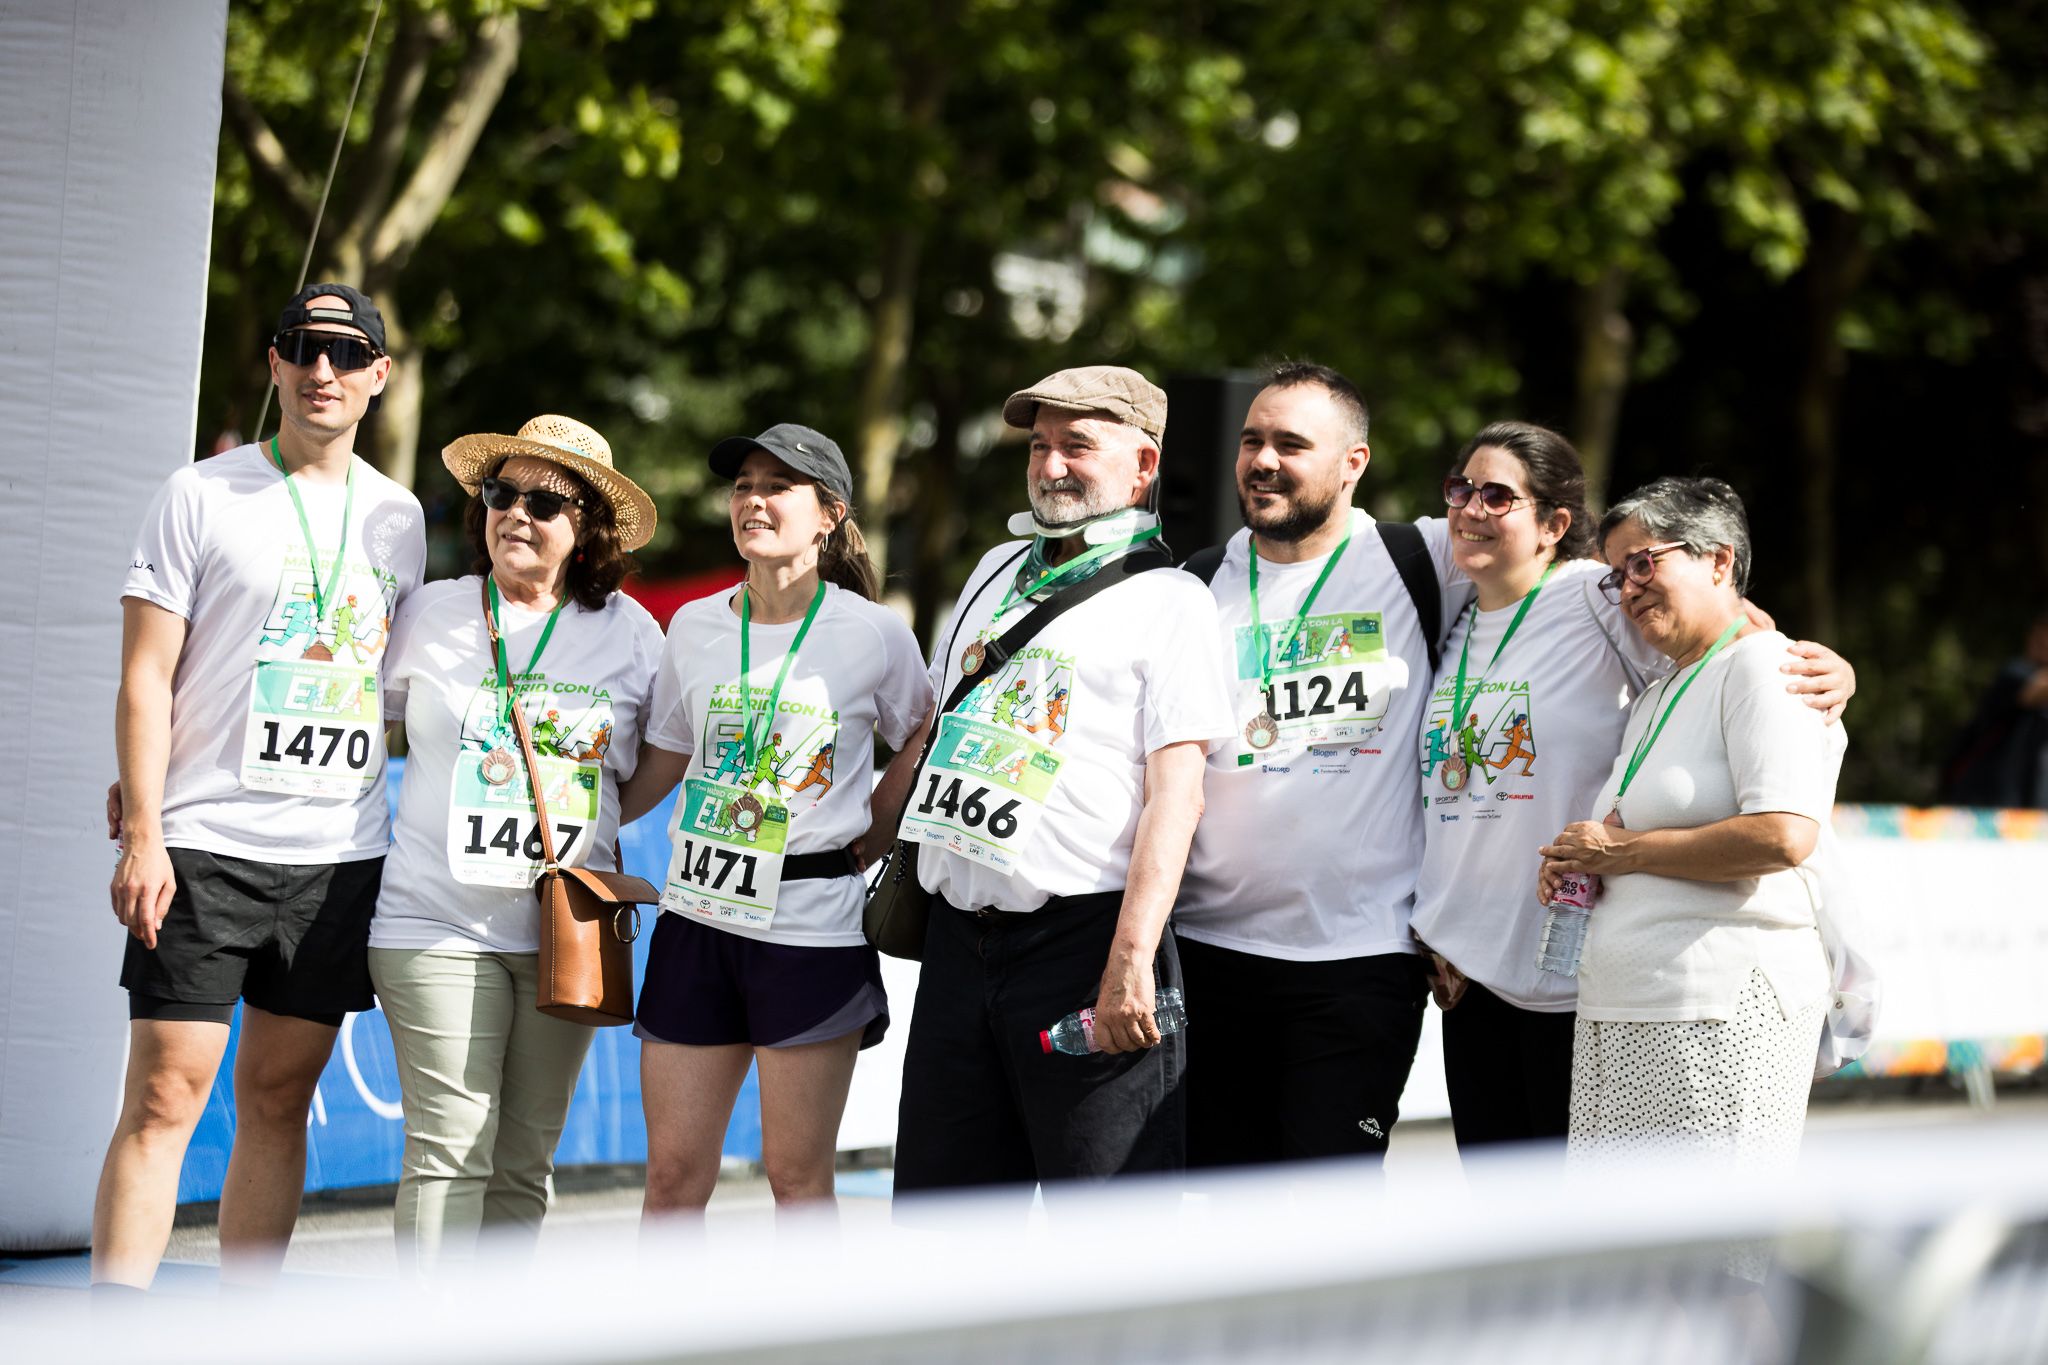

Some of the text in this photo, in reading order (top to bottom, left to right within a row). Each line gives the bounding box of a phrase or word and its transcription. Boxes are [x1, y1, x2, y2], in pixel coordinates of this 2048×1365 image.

[1309, 619, 1332, 628] CON
[1026, 647, 1055, 661] CON
[552, 682, 591, 695] CON
[1266, 671, 1369, 721] 1124
[1479, 682, 1508, 695] CON
[1509, 681, 1529, 692] LA
[778, 700, 815, 717] CON
[820, 711, 839, 723] LA
[259, 720, 370, 770] 1470
[1312, 748, 1338, 758] Biogen
[949, 731, 1028, 785] ELA
[1268, 766, 1291, 774] MADRID
[918, 773, 1022, 839] 1466
[464, 814, 583, 863] 1467
[680, 839, 758, 898] 1471
[1359, 1120, 1384, 1139] CRIVIT
